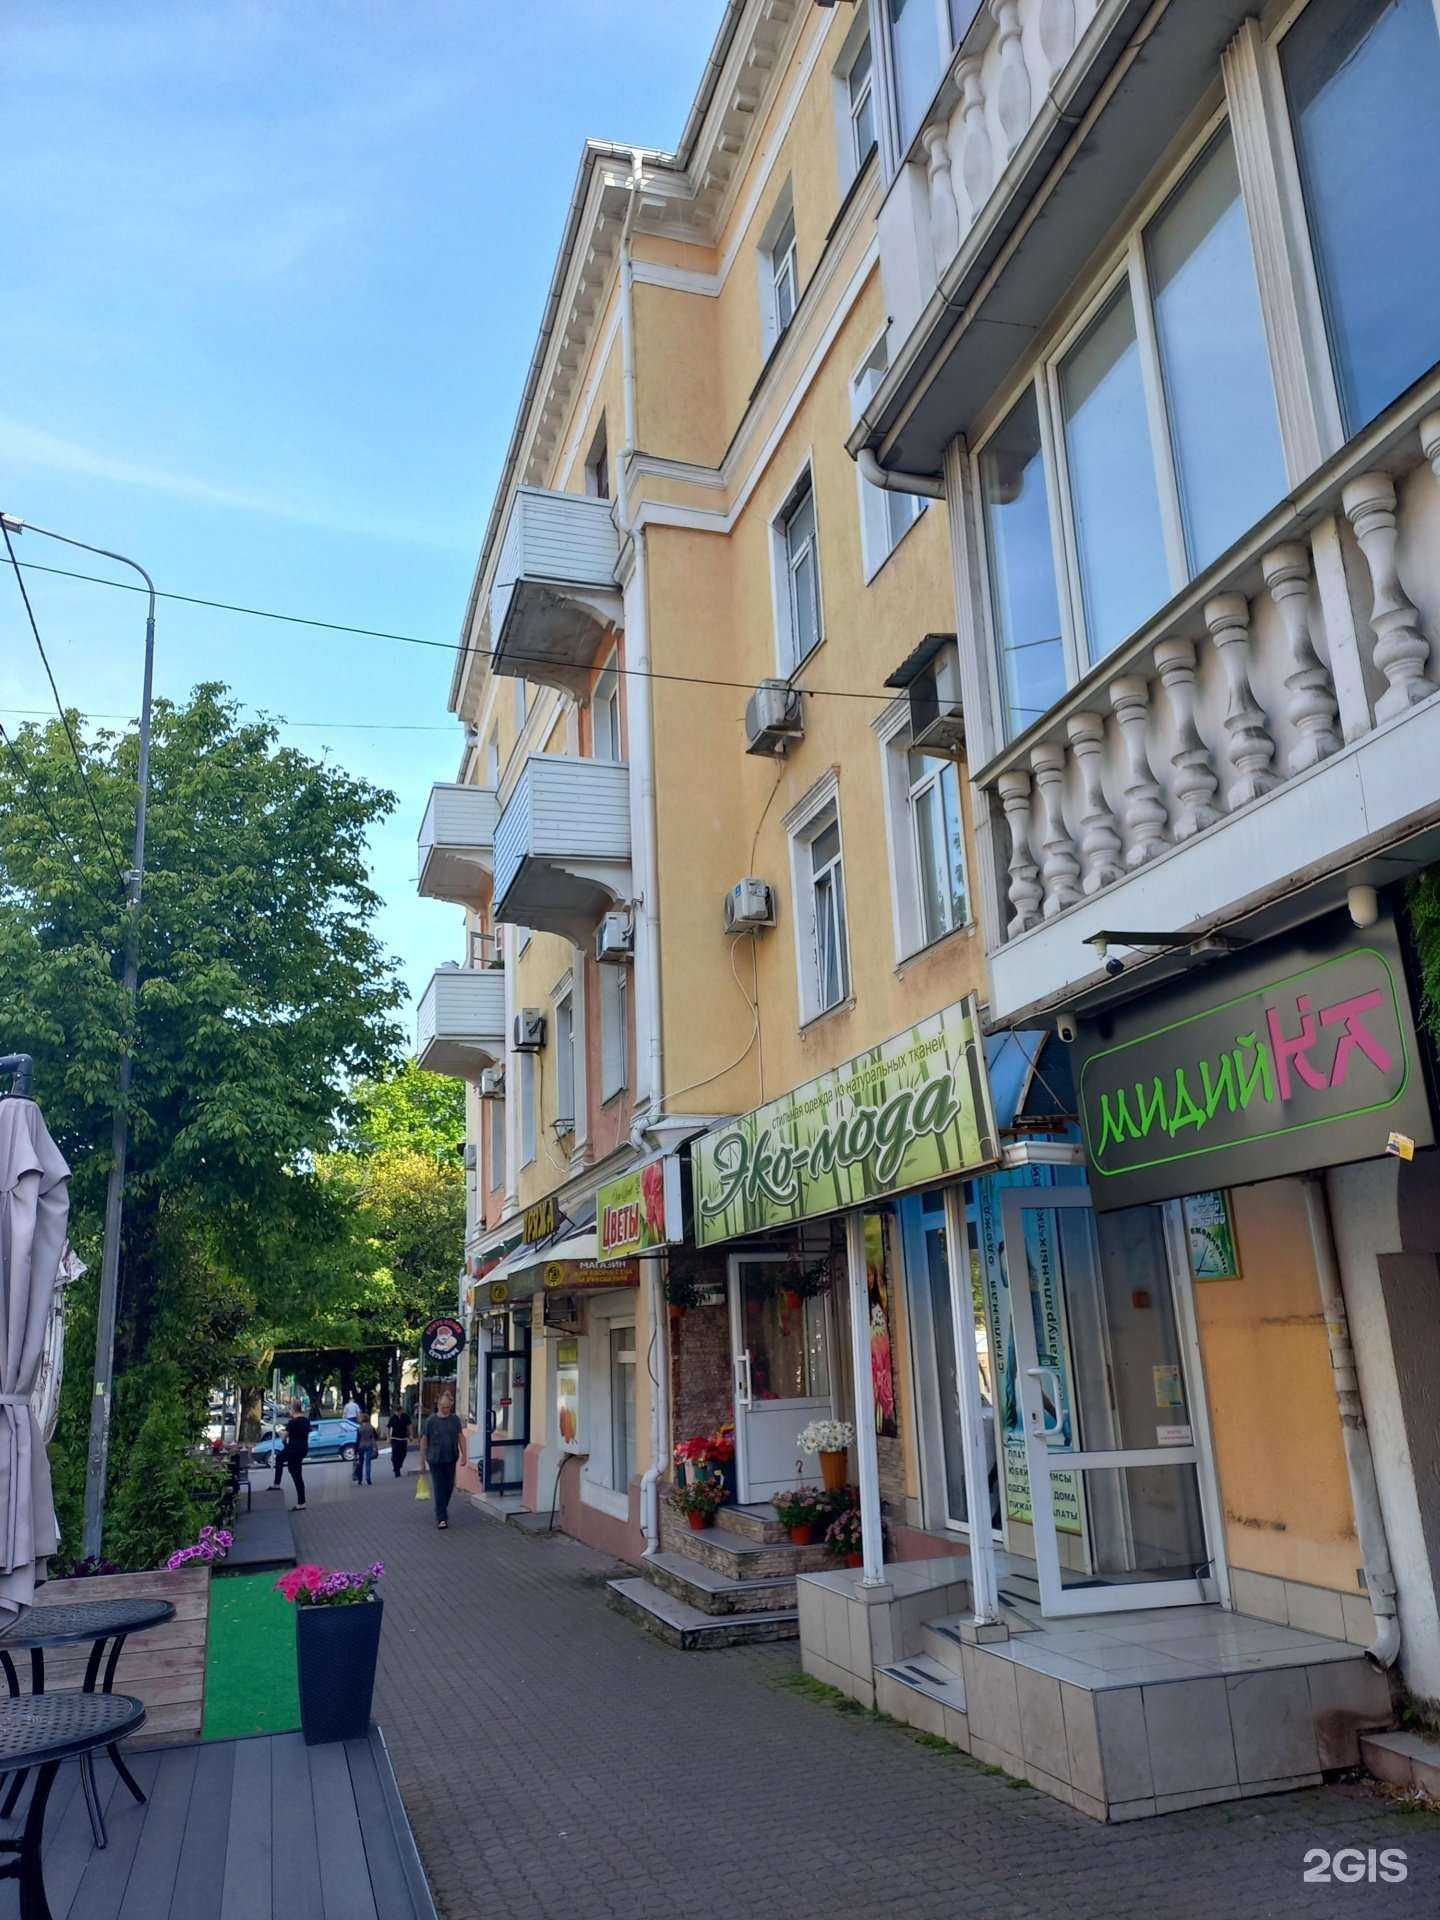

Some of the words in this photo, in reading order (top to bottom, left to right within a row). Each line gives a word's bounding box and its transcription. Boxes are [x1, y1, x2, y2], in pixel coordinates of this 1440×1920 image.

[771, 1106, 803, 1128] стильная
[804, 1089, 833, 1114] одежда
[834, 1082, 845, 1099] из
[845, 1056, 907, 1095] натуральных
[908, 1034, 946, 1063] тканей
[701, 1073, 961, 1216] Эко-мода
[579, 1260, 627, 1270] МАГАЗИН
[990, 1280, 1005, 1374] стильная
[1053, 1490, 1077, 1502] ДОМА
